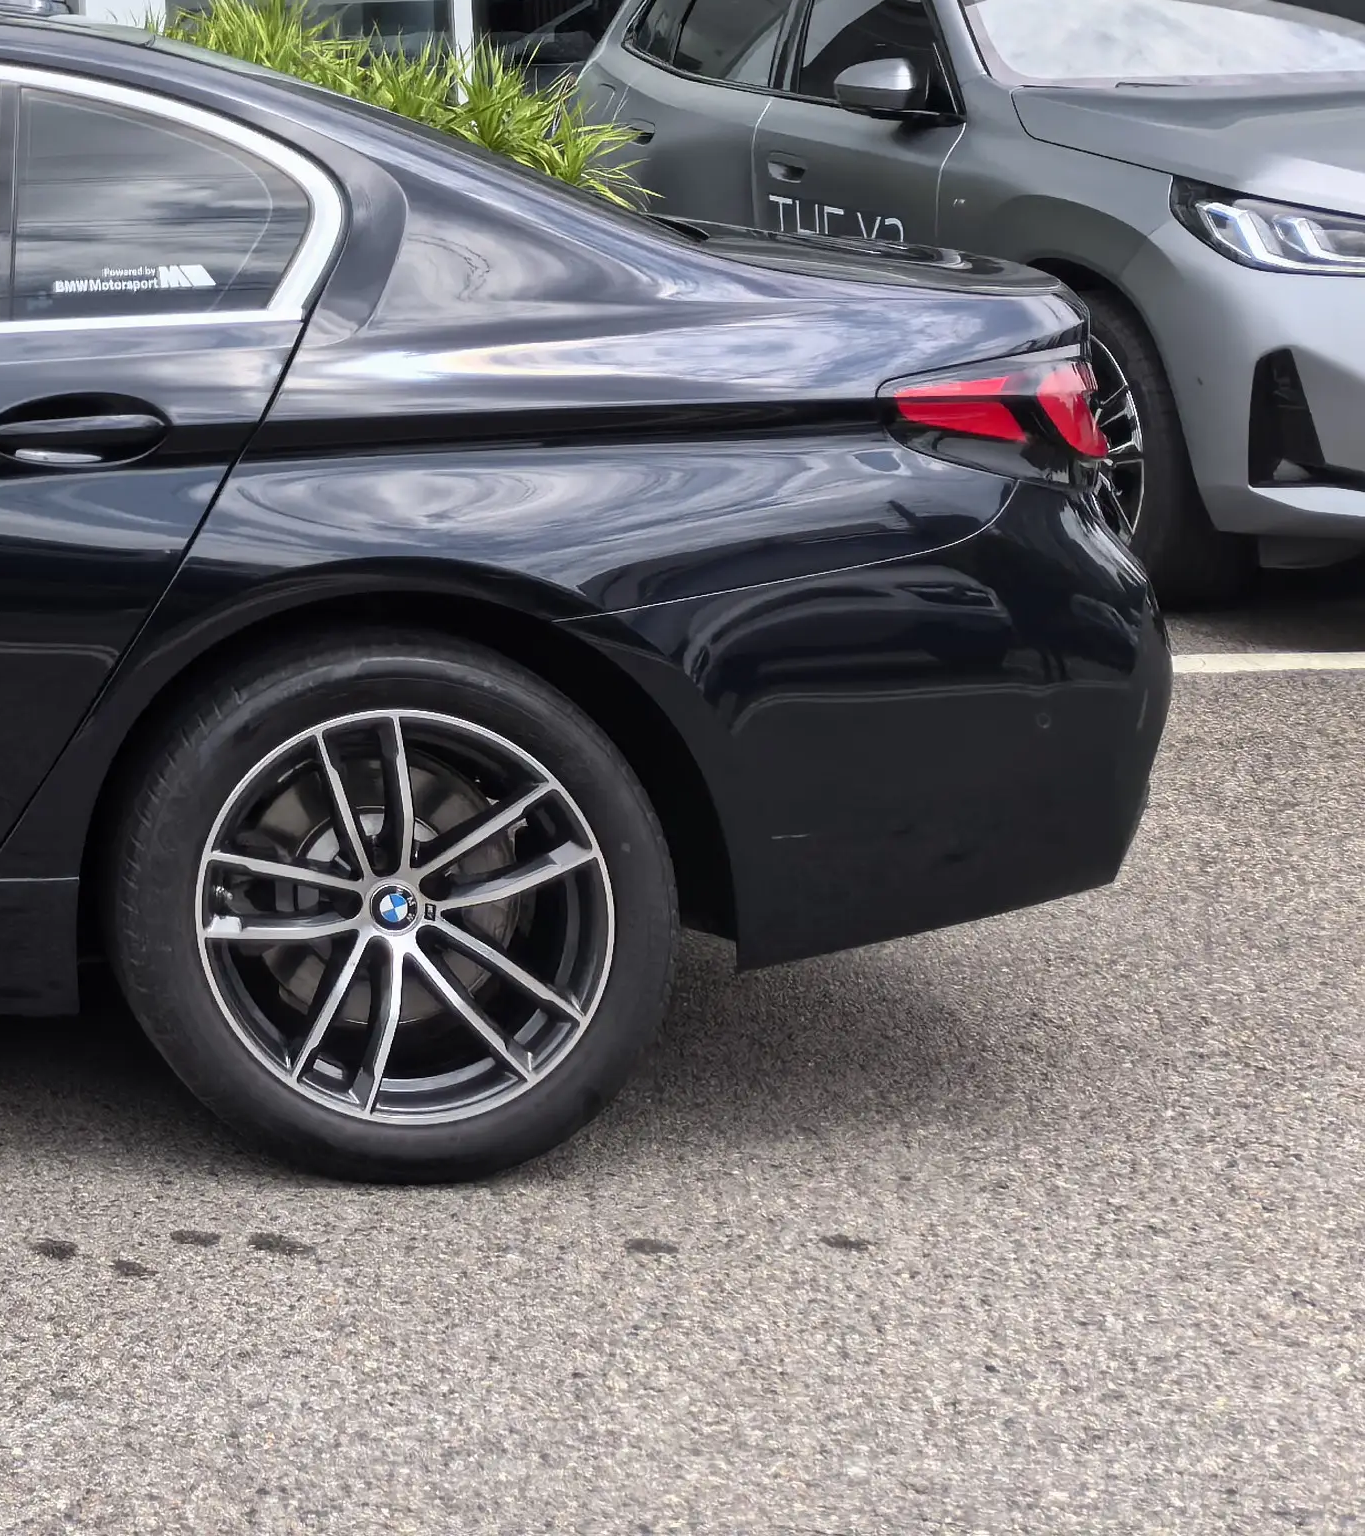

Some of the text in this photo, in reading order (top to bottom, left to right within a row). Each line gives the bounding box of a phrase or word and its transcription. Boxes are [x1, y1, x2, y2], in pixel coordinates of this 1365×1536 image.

[102, 266, 156, 277] Powered by
[54, 279, 88, 293] BMW
[89, 278, 158, 292] Motorsport
